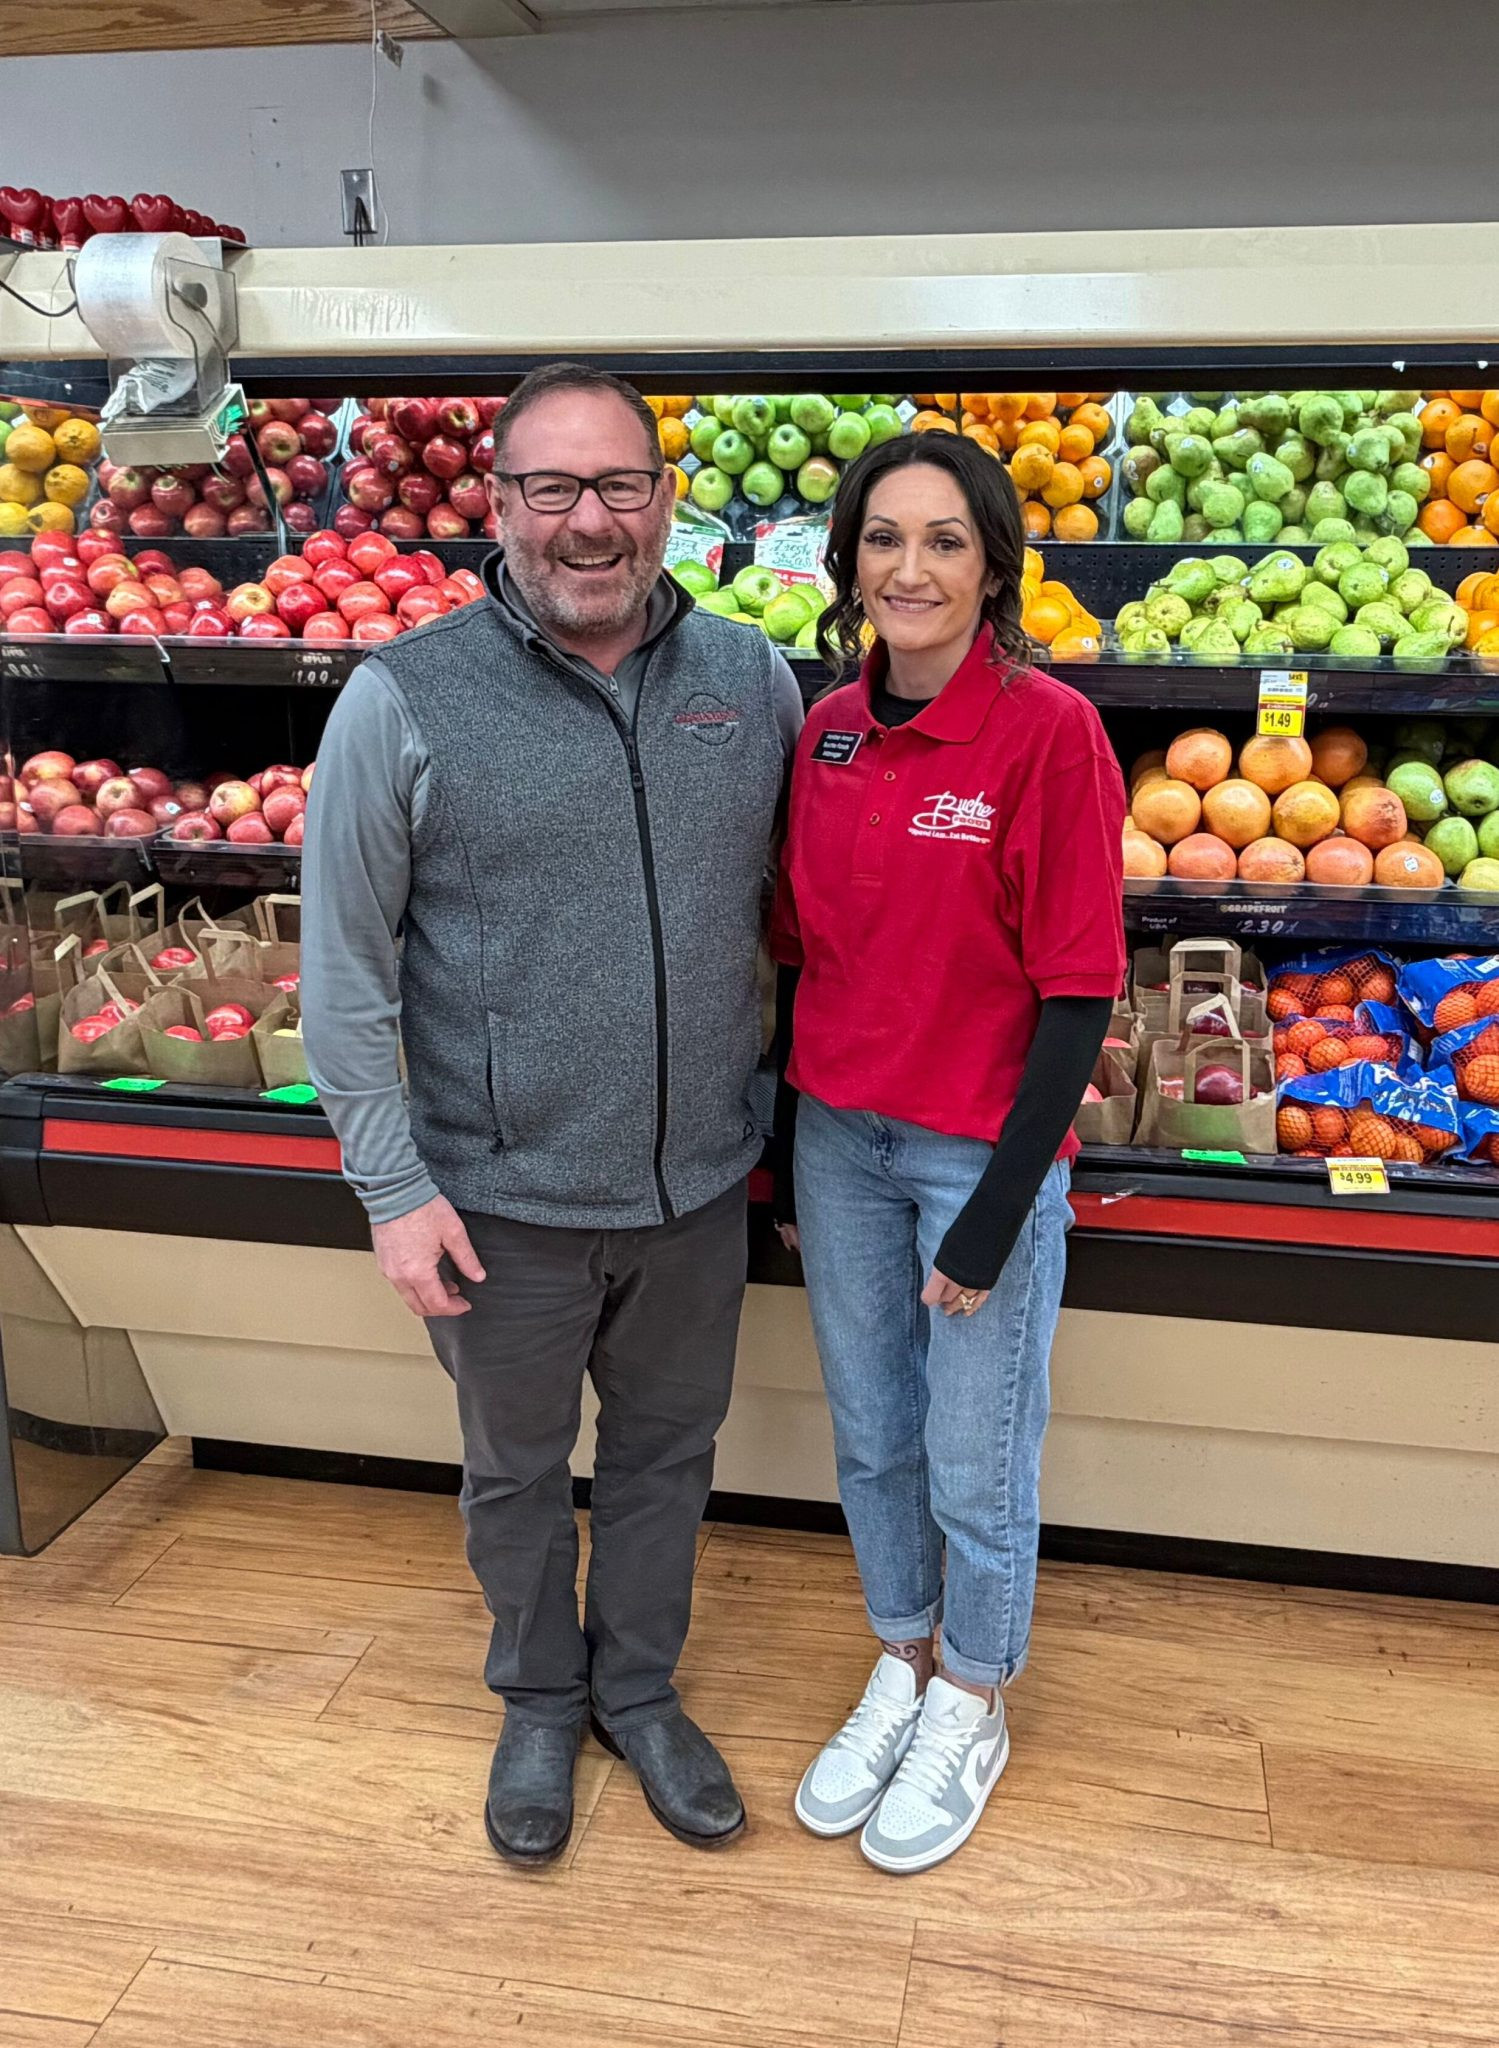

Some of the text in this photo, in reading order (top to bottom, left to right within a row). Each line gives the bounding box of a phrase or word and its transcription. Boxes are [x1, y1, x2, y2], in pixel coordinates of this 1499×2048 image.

[1264, 712, 1291, 728] $1.49
[1228, 904, 1288, 913] GRAPEFRUIT
[1339, 1172, 1372, 1184] $4.99
